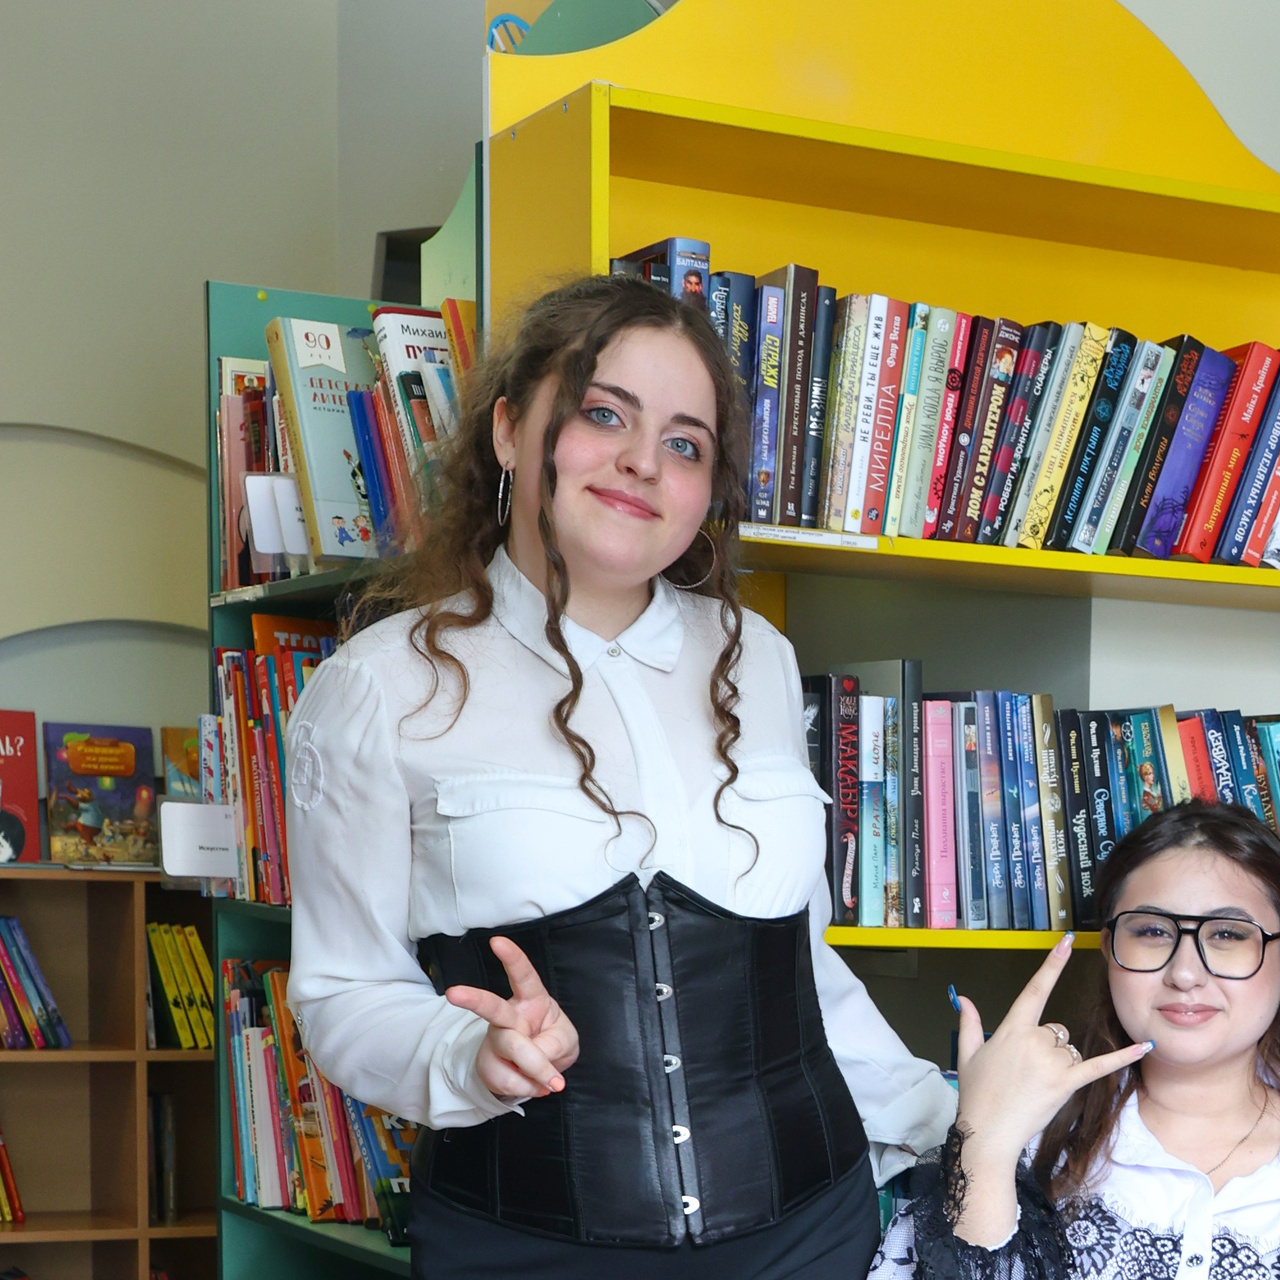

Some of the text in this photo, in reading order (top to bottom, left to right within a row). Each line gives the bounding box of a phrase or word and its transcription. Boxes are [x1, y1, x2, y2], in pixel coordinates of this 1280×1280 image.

[303, 331, 331, 351] 90
[767, 296, 779, 325] MARVEL
[764, 333, 780, 389] СТРАЖИ
[792, 291, 807, 436] КРЕСТОВЫЙ ПОХОД ДЖИНСАХ
[859, 315, 884, 443] НЕ РЕВИ, ТЫ ЕЩЕ ЖИВ
[922, 336, 948, 420] КОГДА ВЫРОС
[809, 417, 824, 439] ДВЕ
[870, 384, 897, 492] МИРЕЛЛА
[936, 393, 955, 467] ГЕРОЙ ЛОНДОНА
[966, 382, 1006, 521] ДОМ С ХАРАКТЕРОМ
[998, 473, 1016, 512] РОБЕРТ
[1011, 414, 1033, 462] ЗОННТАГ
[1032, 349, 1054, 396] СКАНЕРЫ
[1203, 356, 1273, 533] Затерянный мир Майкл Крайтон
[947, 483, 960, 515] Кристина
[1246, 449, 1274, 506] ЛЕДЯНЫХ
[1234, 508, 1255, 543] ЧАСОВ
[838, 723, 859, 819] МАКАБР
[1092, 788, 1111, 837] Северное
[1073, 808, 1095, 898] Чудесный нож
